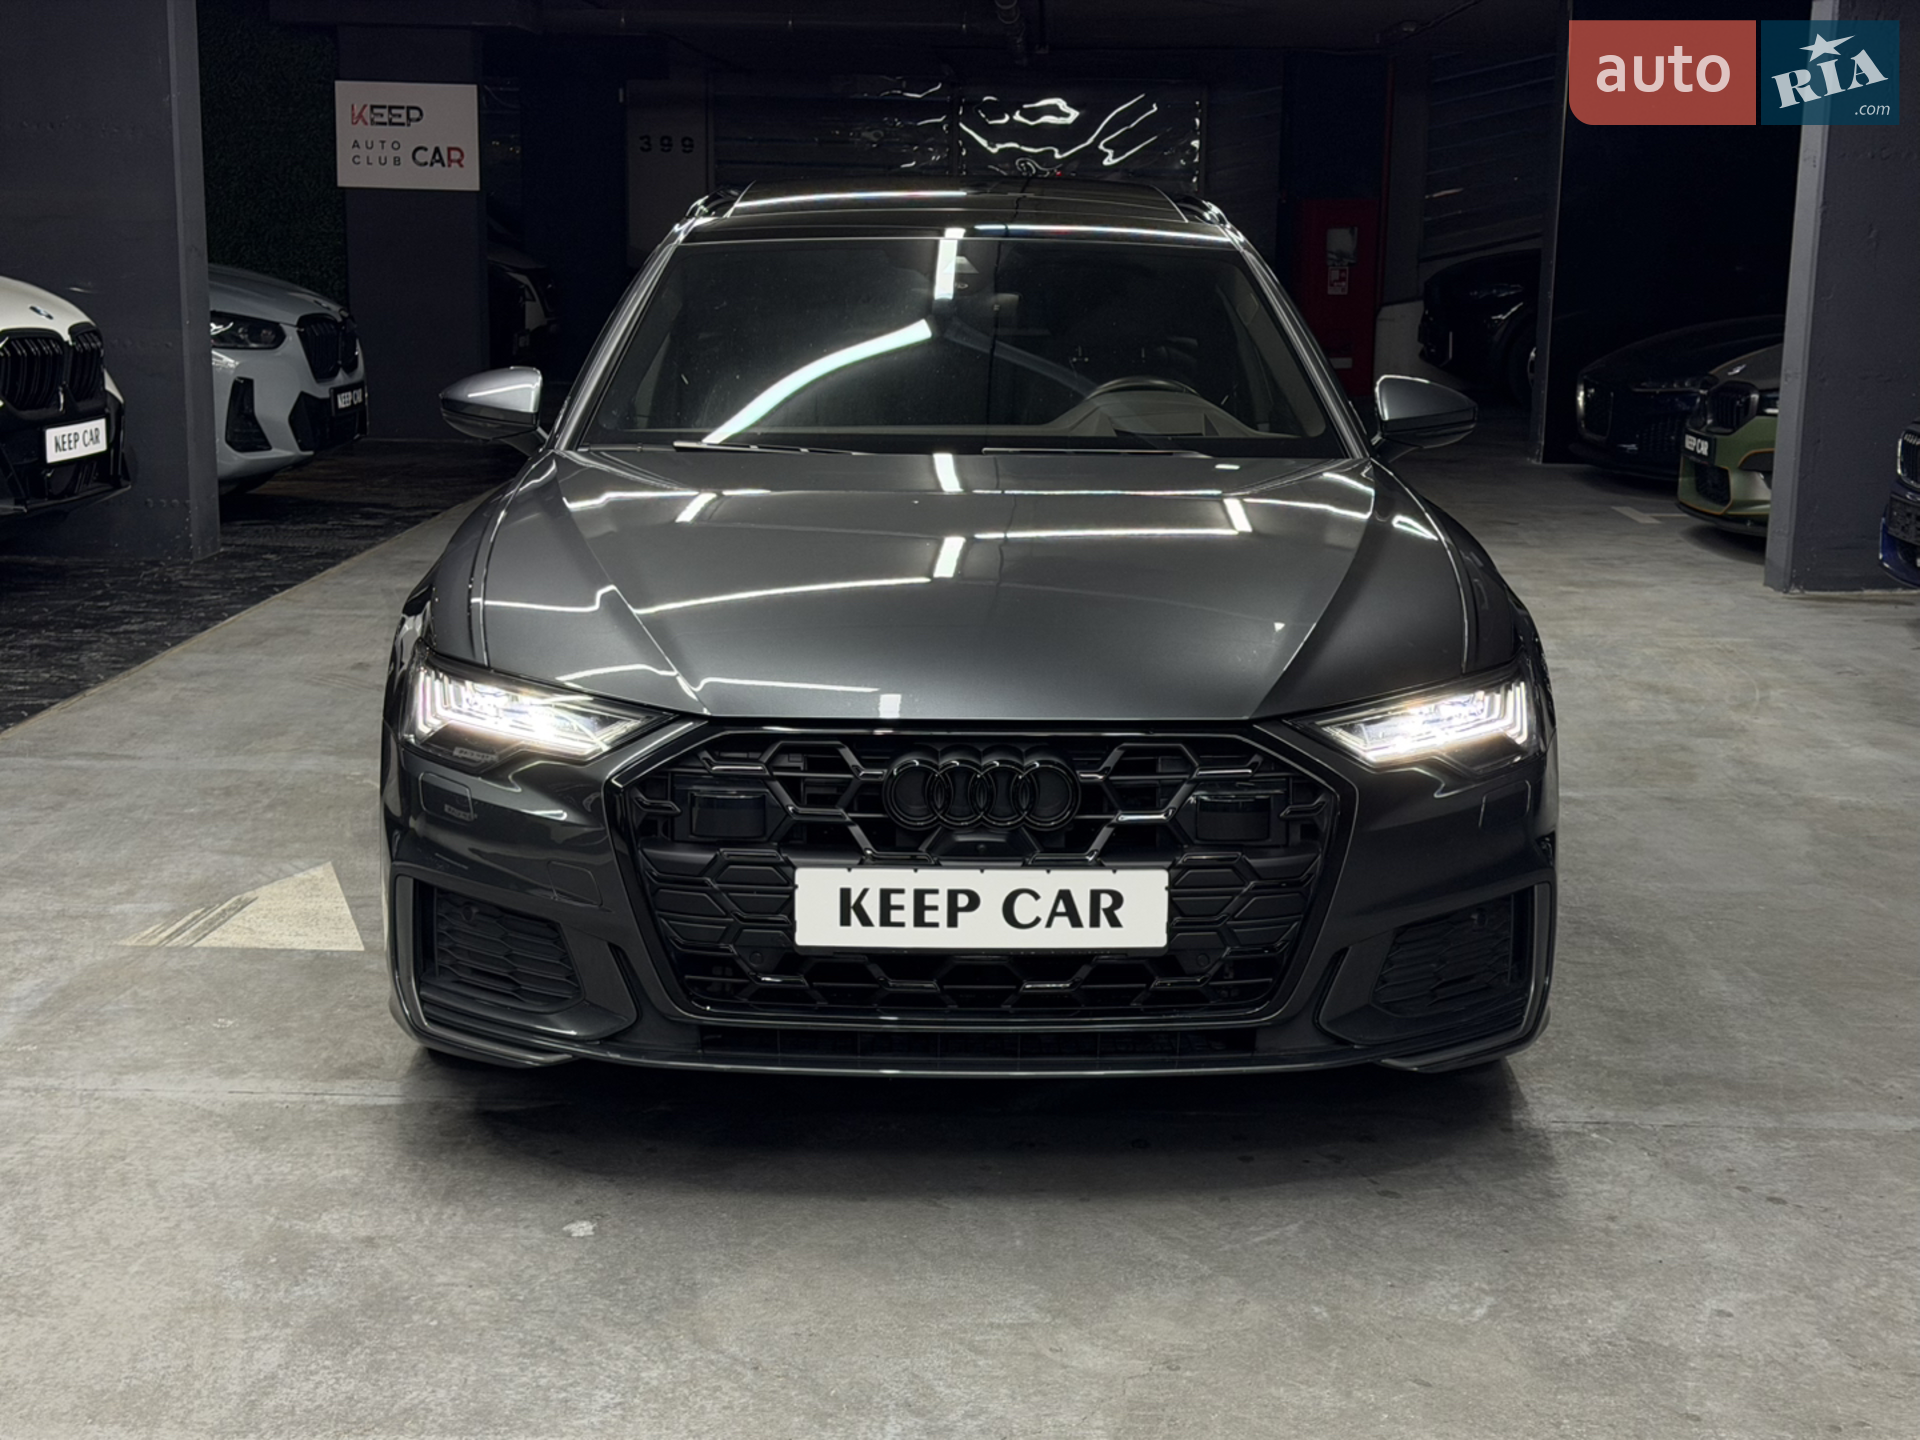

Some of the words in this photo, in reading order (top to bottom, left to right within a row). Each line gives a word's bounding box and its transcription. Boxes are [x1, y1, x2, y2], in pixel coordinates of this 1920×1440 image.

[351, 104, 424, 127] KEEP
[352, 140, 401, 150] AUTO
[412, 145, 465, 168] CAR
[352, 155, 401, 166] CLUB
[54, 431, 80, 453] KEEP
[82, 427, 101, 447] CAR
[839, 887, 981, 929] KEEP
[1001, 888, 1125, 930] CAR
